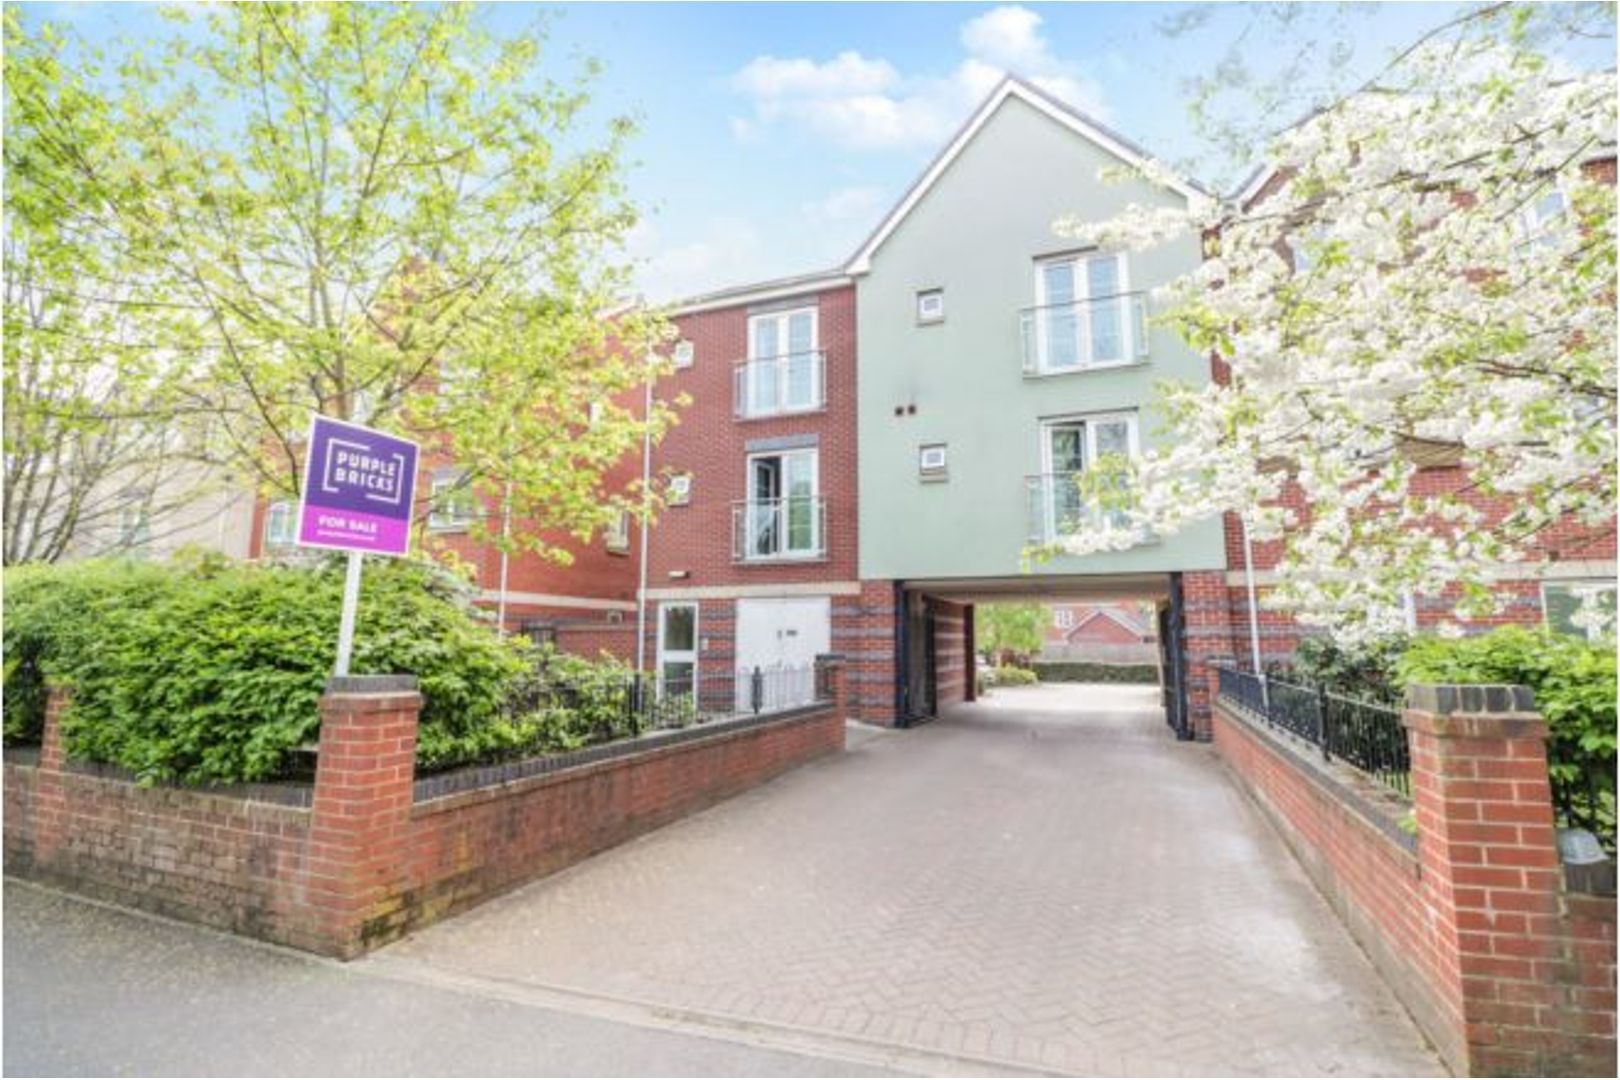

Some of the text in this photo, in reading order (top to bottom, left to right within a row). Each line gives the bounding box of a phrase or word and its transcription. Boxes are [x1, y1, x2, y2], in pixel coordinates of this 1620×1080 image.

[336, 451, 396, 477] PURPLE
[334, 467, 394, 492] BRICKS
[318, 515, 378, 533] FOR SALE
